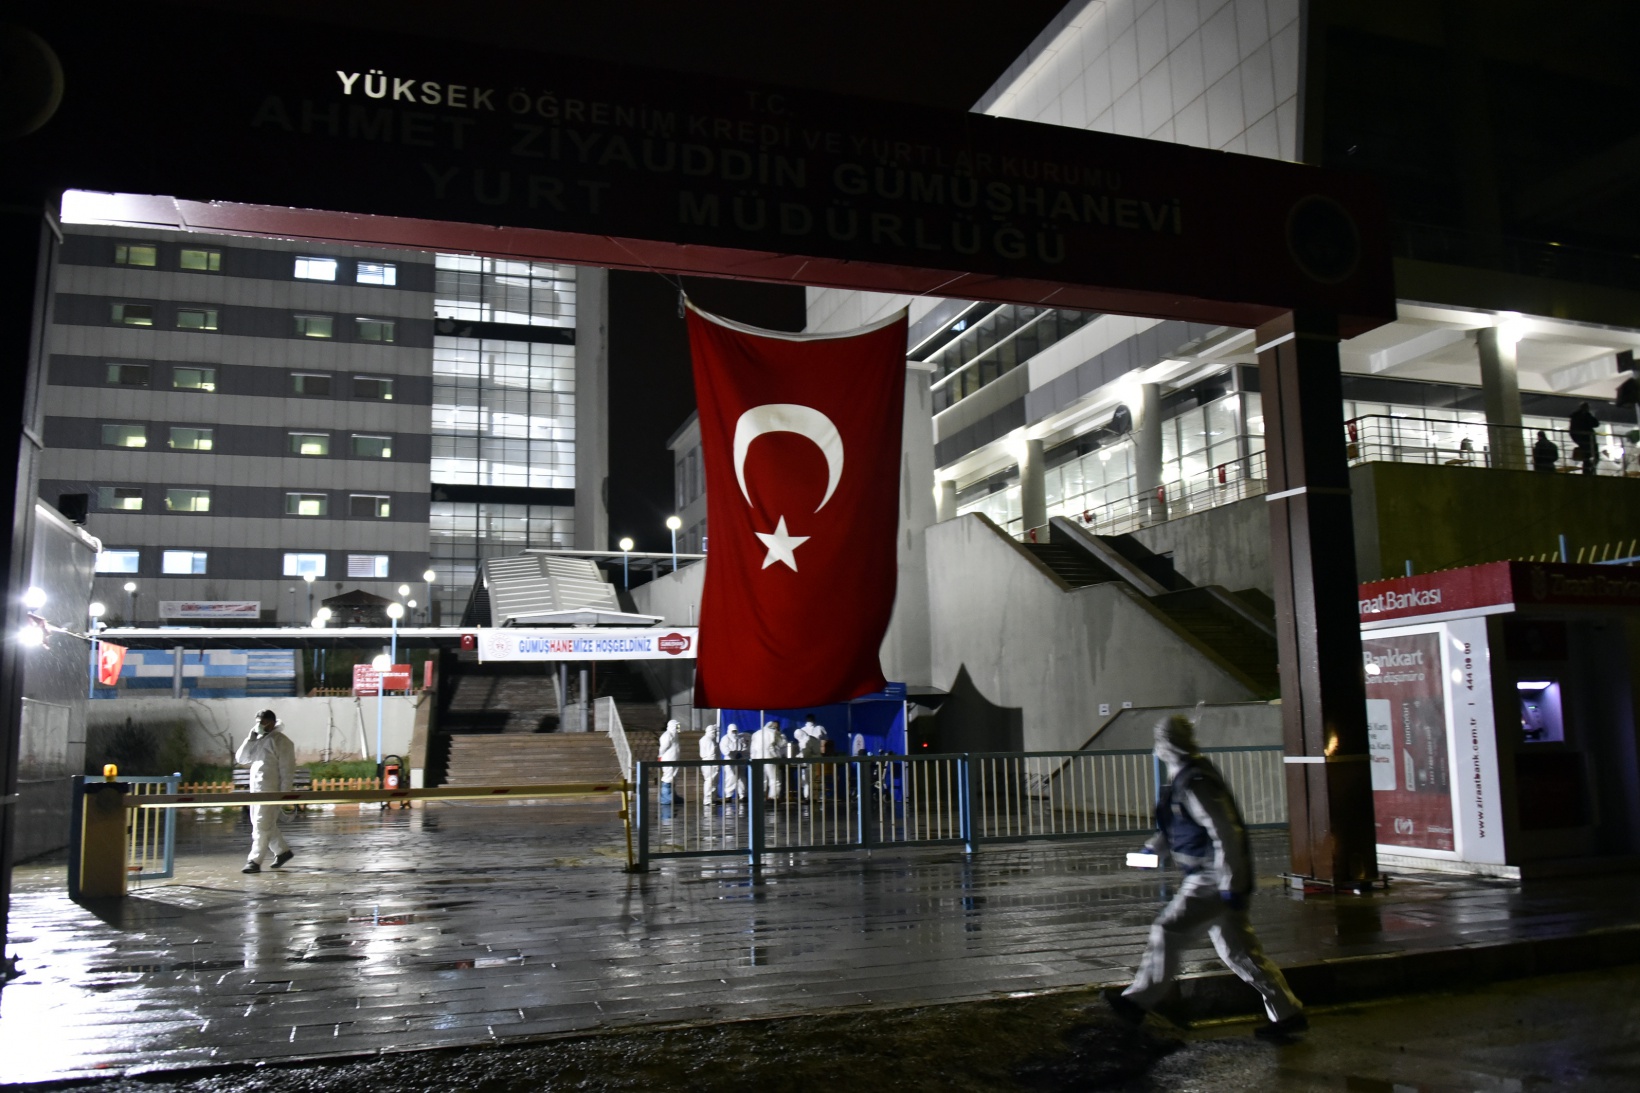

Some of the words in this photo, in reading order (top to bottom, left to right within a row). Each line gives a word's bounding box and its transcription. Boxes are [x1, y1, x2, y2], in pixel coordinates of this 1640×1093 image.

[336, 69, 495, 111] YÜKSEK
[507, 86, 676, 133] ÖĞRENİM
[688, 114, 791, 148] KREDİ
[802, 129, 842, 154] VE
[849, 135, 992, 174] YURTLAR
[1001, 155, 1123, 191] KURUMU
[250, 94, 476, 150] AHMET
[510, 118, 806, 189] ZİYAÜDDİN
[833, 158, 1183, 235] GÜMÜŞHANEVİ
[422, 162, 611, 214] YURT
[679, 189, 1066, 264] MÜDÜRLÜĞÜ
[1386, 587, 1442, 611] Bankası
[518, 637, 593, 655] GÜMÜŞHANEMİZE
[595, 636, 652, 654] HOŞGELDİNİZ
[1363, 648, 1424, 669] Bankkart
[1465, 672, 1474, 691] 444
[1470, 717, 1485, 839] www.ziraatbank.com.tr
